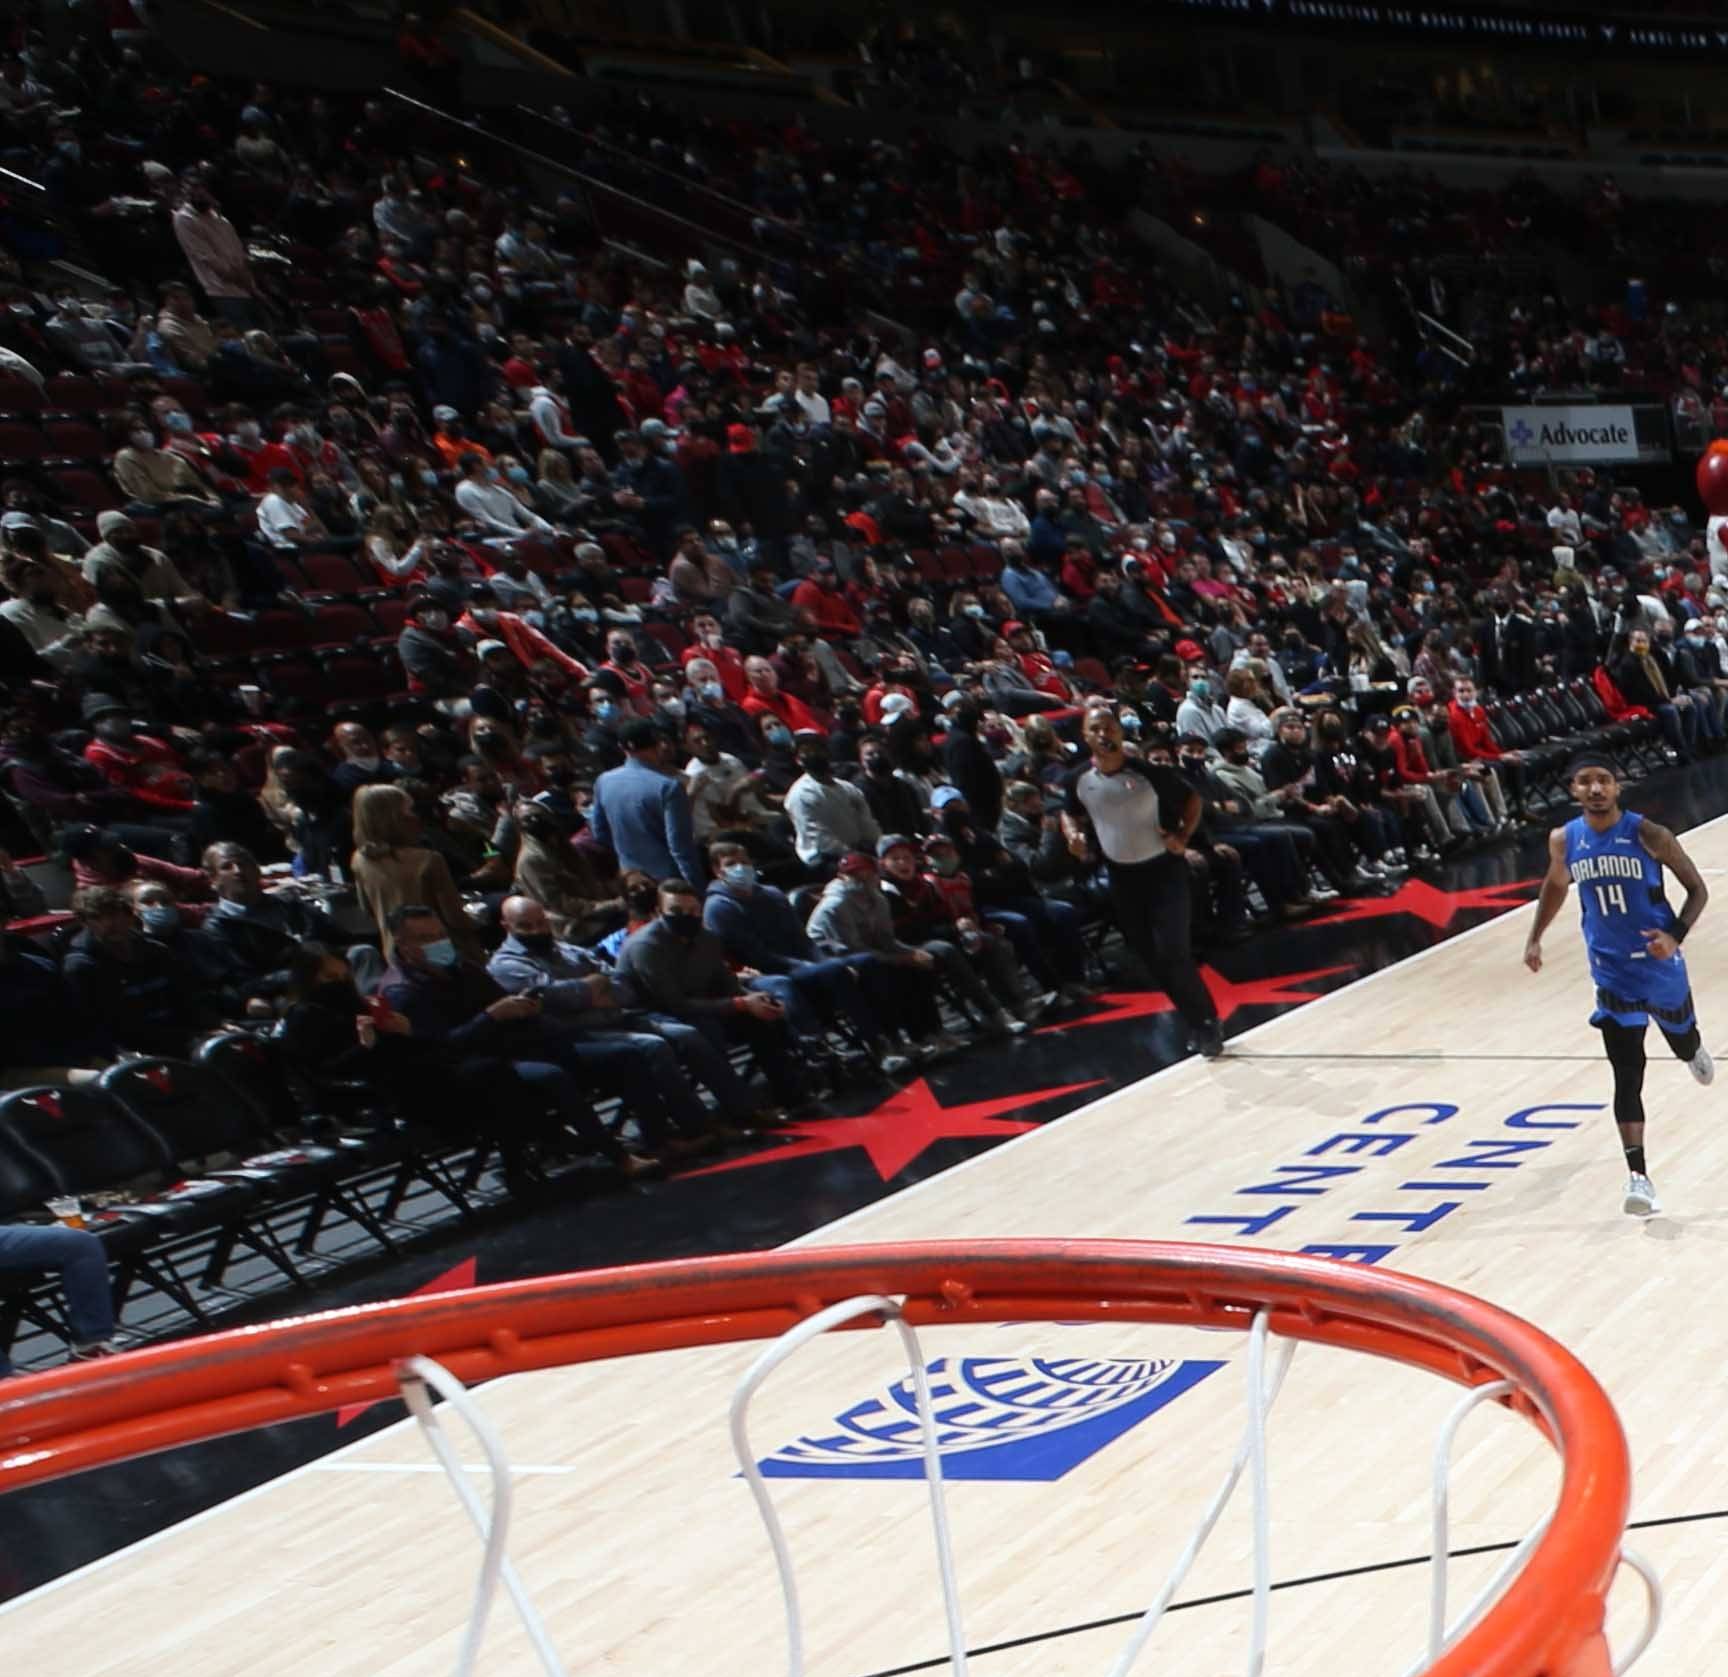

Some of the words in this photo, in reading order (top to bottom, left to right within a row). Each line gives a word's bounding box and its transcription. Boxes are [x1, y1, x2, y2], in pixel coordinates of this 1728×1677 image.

[1540, 420, 1629, 446] Advocate
[1570, 855, 1643, 882] ORLANDO
[1594, 883, 1629, 918] 14
[1182, 1102, 1461, 1236] CENT
[1298, 1102, 1610, 1268] UNITE
